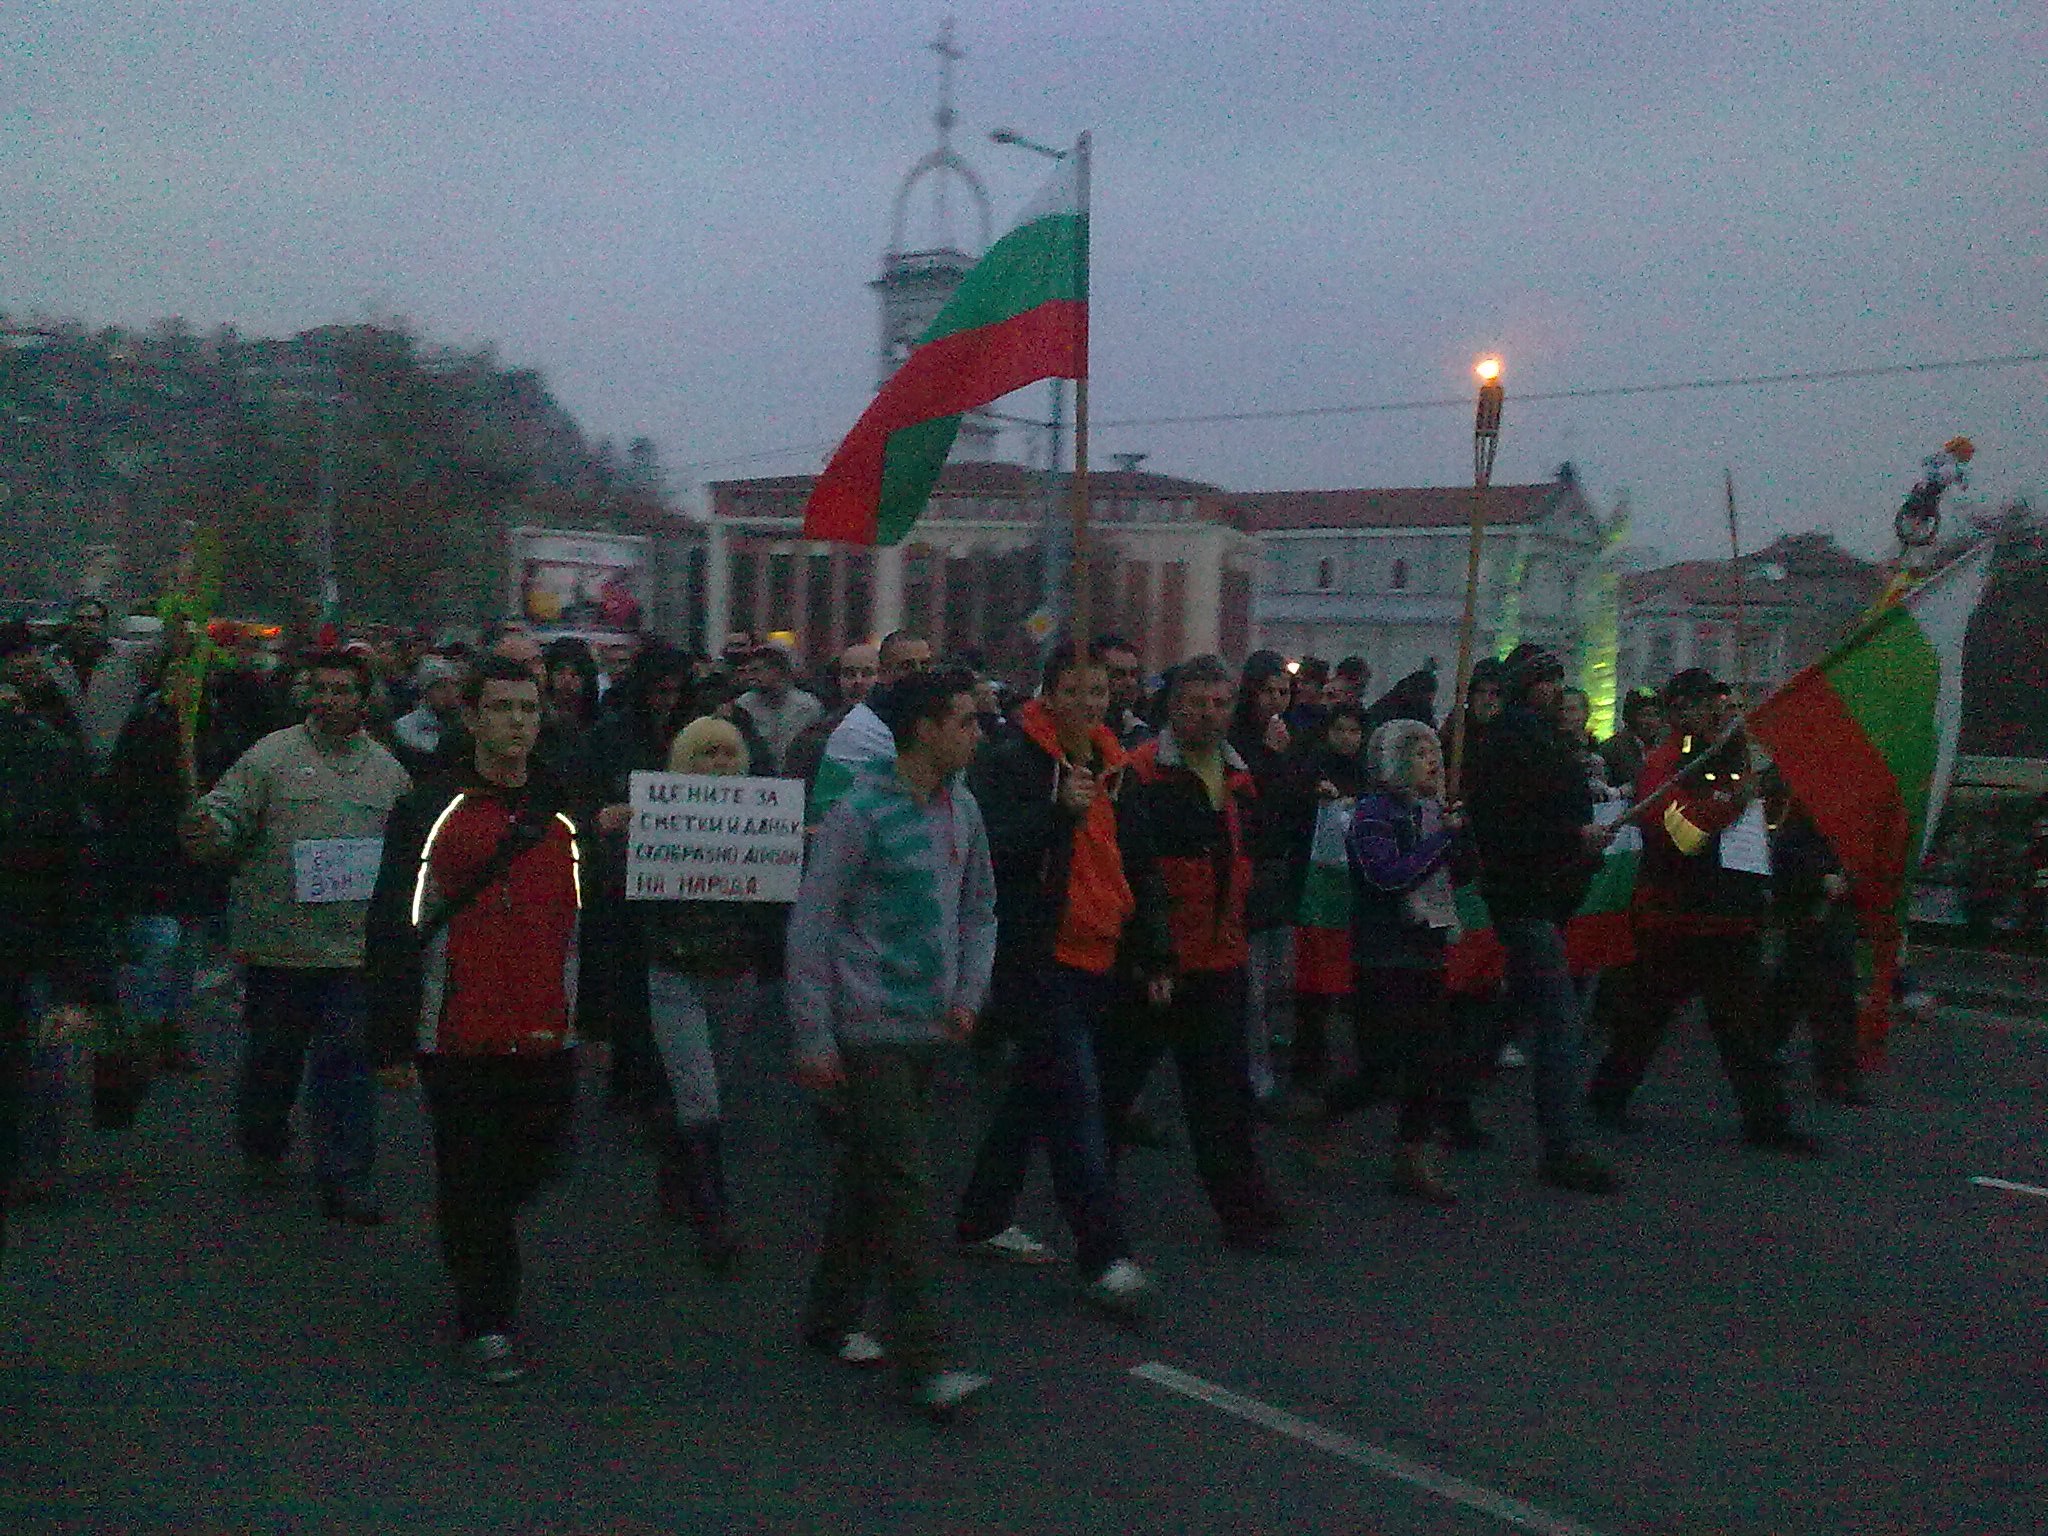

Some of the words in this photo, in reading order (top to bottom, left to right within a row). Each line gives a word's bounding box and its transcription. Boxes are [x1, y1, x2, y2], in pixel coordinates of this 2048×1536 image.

[649, 783, 744, 804] ЦЕНИТЕ
[756, 788, 778, 806] ЗА
[641, 811, 722, 832] СМЕТКИ
[637, 871, 665, 893] НА
